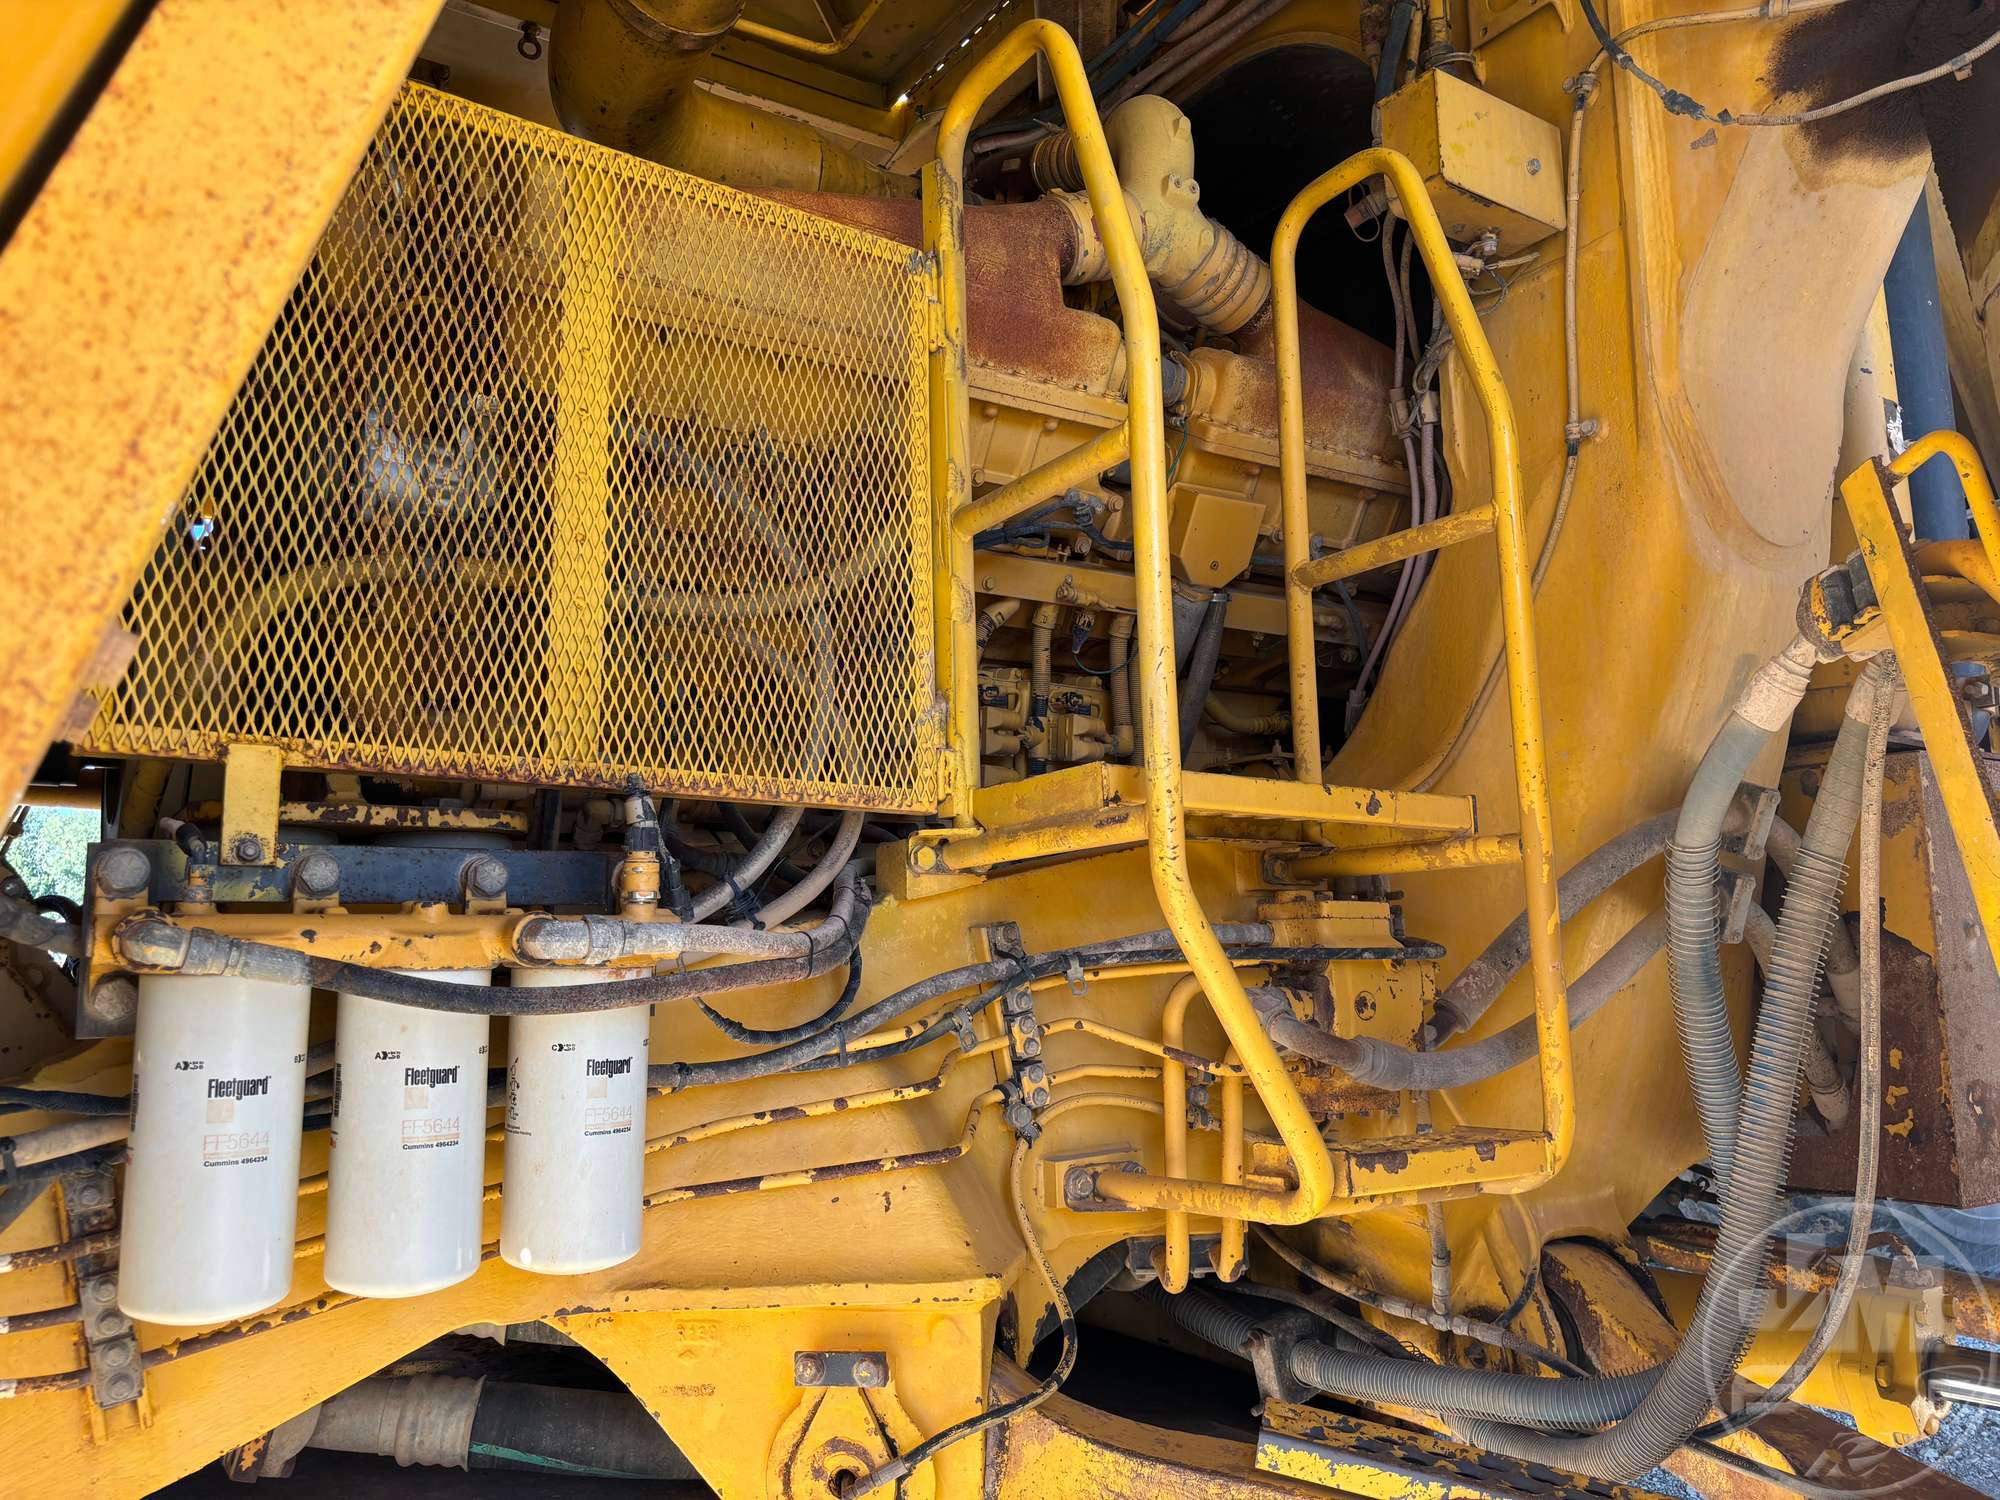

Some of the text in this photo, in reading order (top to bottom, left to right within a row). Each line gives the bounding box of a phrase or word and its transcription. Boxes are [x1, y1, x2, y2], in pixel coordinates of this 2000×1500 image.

[404, 1066, 458, 1089] Fleetguard
[586, 1057, 631, 1078] Fleetguard
[207, 1076, 269, 1100] Fleetguard
[584, 1104, 632, 1124] FF5644
[401, 1116, 460, 1136] FF5644
[584, 1129, 612, 1137] Cummins
[203, 1130, 271, 1151] FF5644
[402, 1143, 434, 1151] Cummins
[203, 1159, 240, 1168] Cummins
